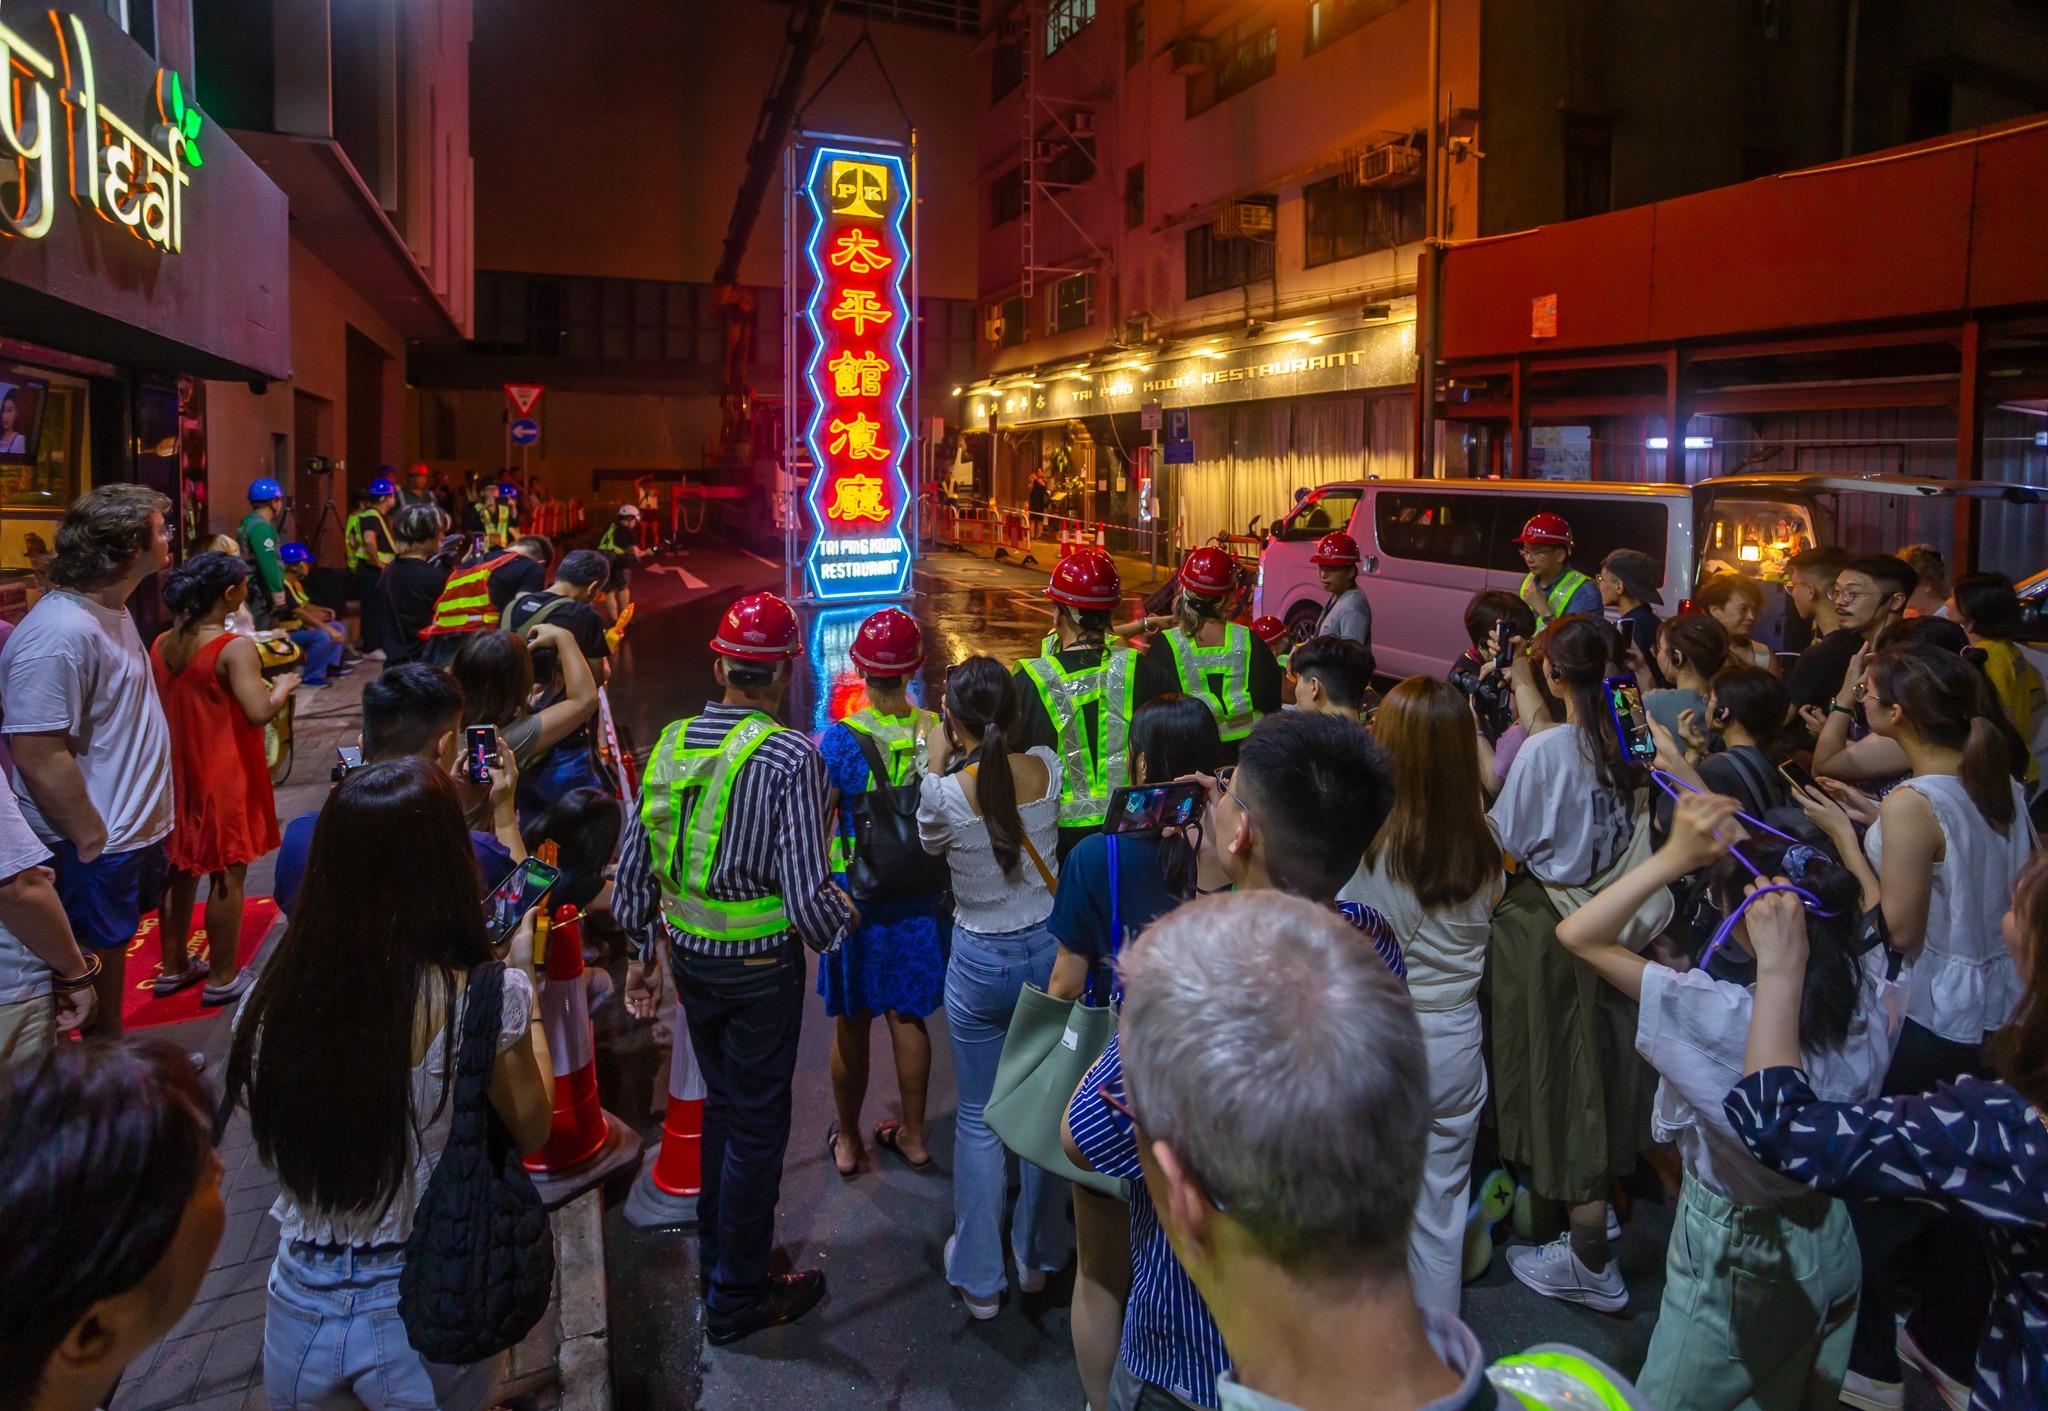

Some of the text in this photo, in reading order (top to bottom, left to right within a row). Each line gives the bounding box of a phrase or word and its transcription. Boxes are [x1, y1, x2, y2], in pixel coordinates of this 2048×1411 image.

[69, 13, 190, 255] leaf
[1072, 390, 1093, 402] TAI
[1143, 377, 1191, 393] KOON
[1201, 350, 1365, 385] RESTAURANT
[1172, 411, 1185, 438] P
[819, 537, 902, 556] TAI PING KOON
[821, 559, 899, 580] RESTAURANT
